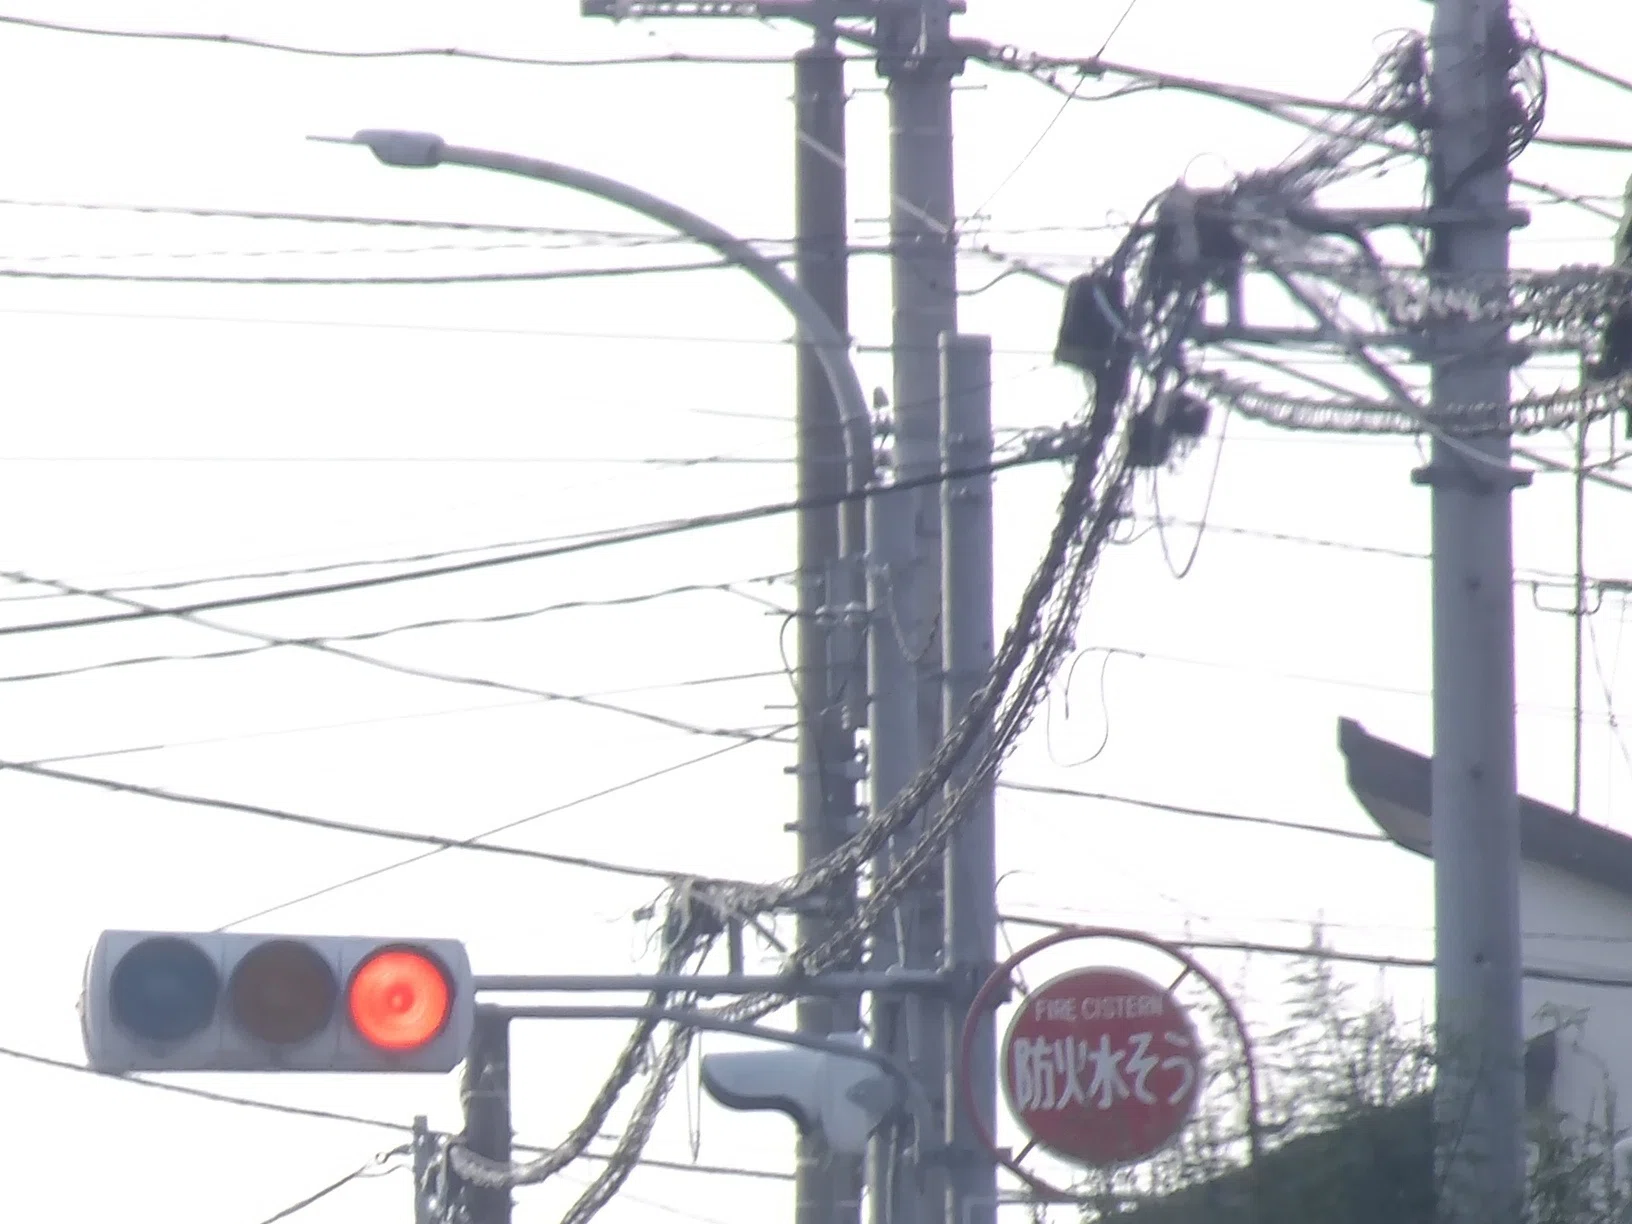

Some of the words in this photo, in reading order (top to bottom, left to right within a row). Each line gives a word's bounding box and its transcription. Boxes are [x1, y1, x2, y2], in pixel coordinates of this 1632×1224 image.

[1034, 998, 1077, 1021] FIRE
[1013, 1031, 1195, 1111] 防火水そう
